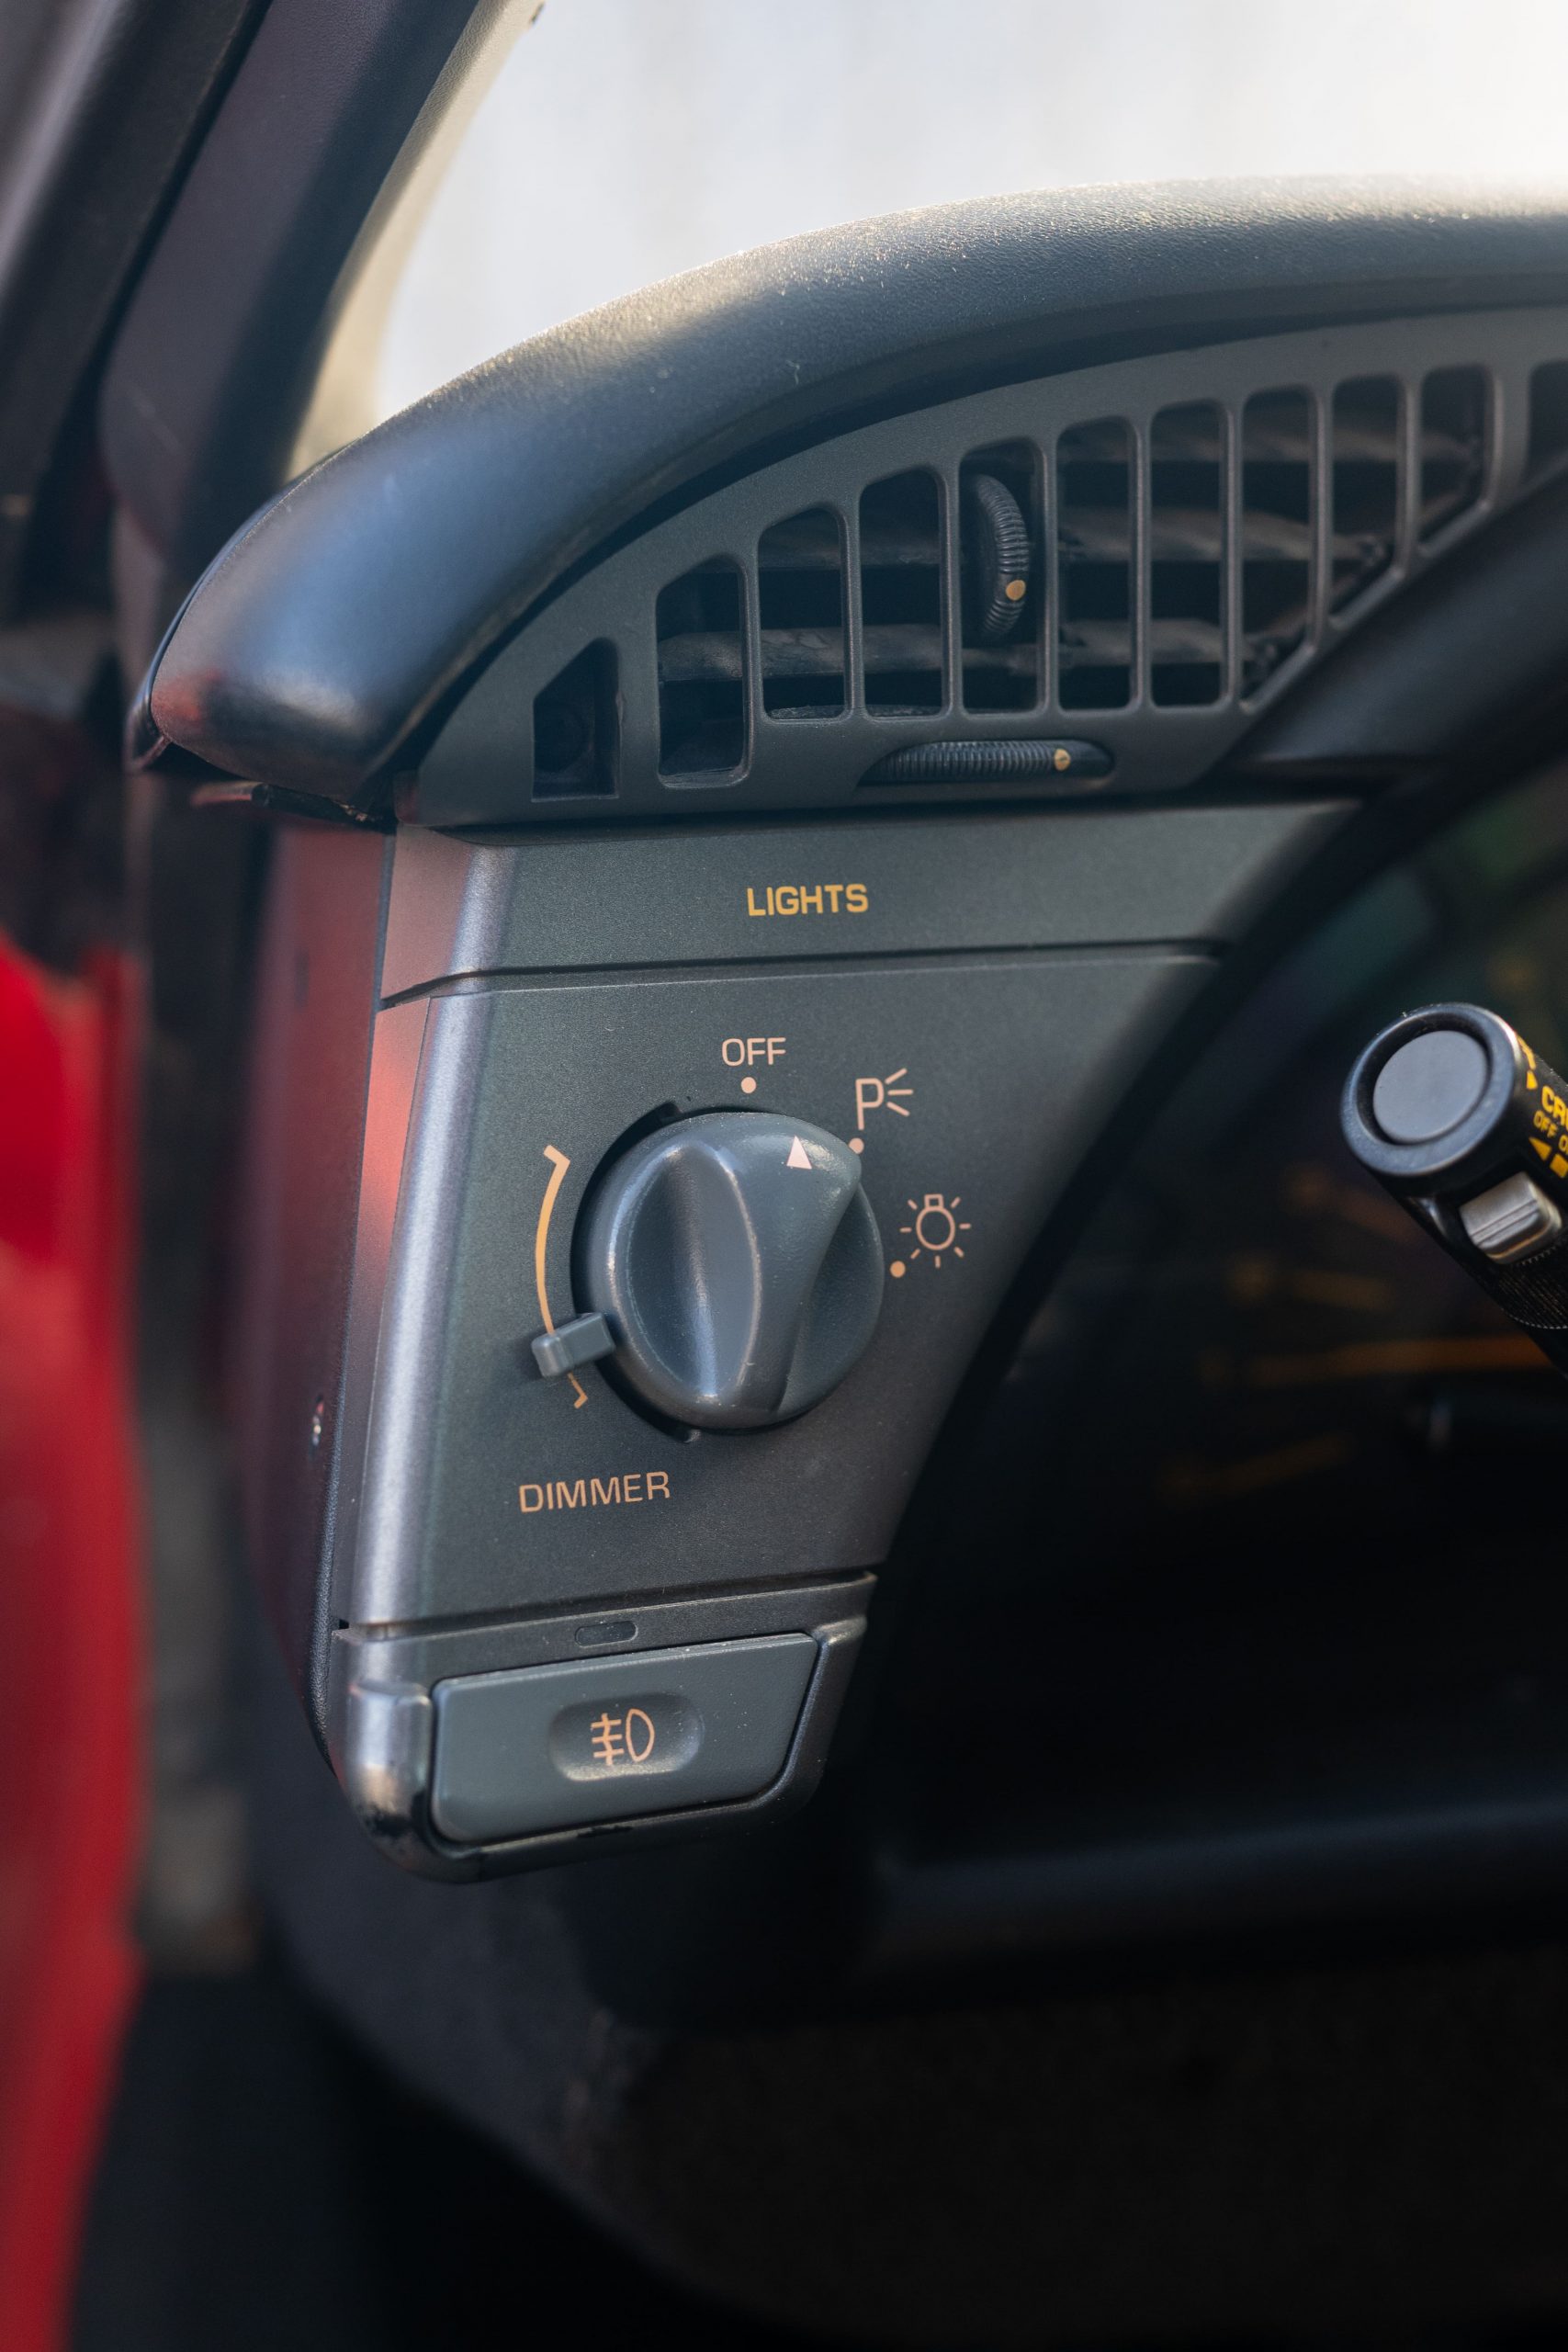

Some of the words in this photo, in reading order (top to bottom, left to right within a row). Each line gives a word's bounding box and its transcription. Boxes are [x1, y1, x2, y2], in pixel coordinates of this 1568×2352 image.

[747, 884, 869, 916] LIGHTS
[722, 1037, 786, 1066] OFF
[855, 1078, 885, 1130] P
[1533, 1110, 1559, 1138] OFF
[1558, 1135, 1568, 1156] O
[519, 1471, 671, 1512] DIMMER
